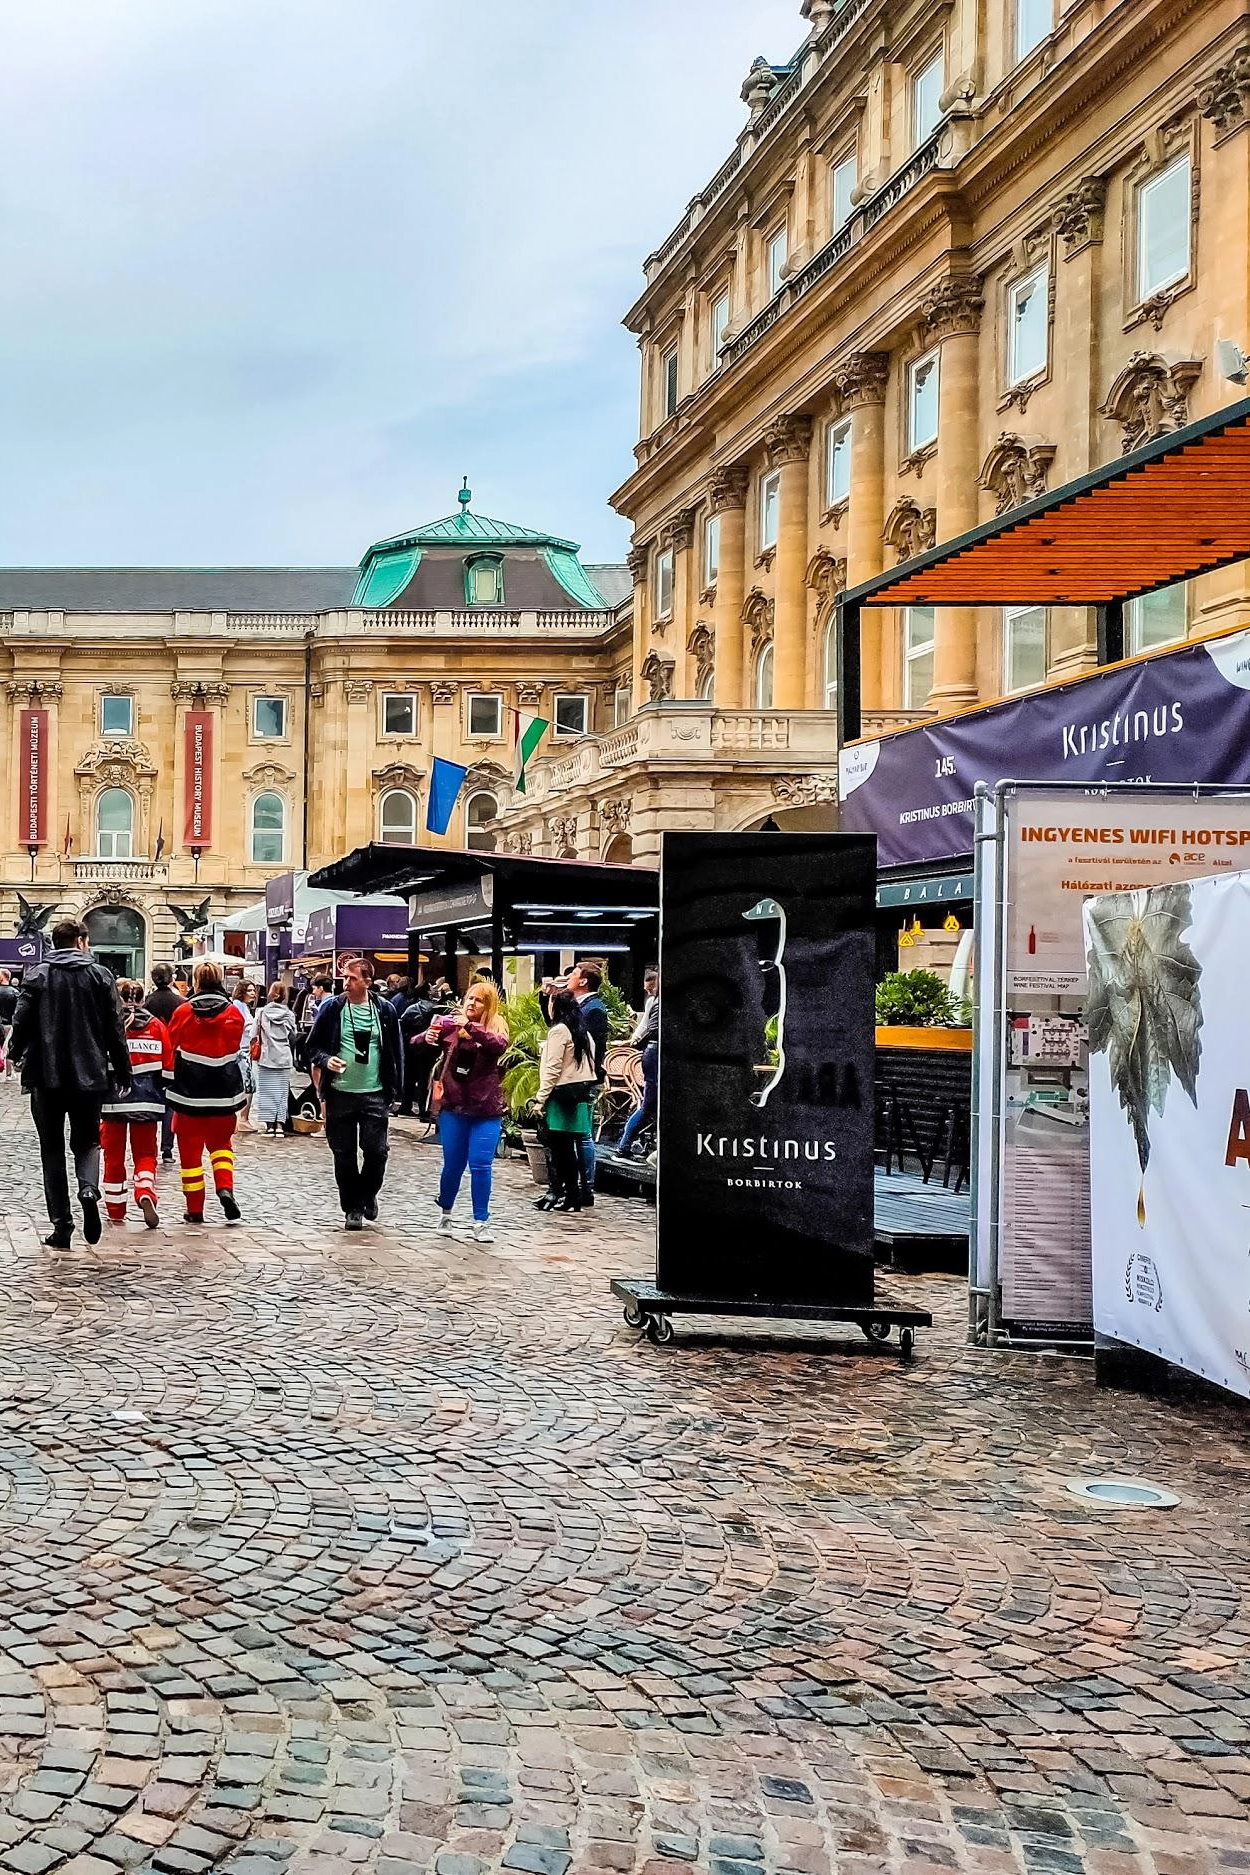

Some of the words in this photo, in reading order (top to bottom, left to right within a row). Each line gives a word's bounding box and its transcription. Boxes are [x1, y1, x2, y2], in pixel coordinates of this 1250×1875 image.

[195, 724, 203, 766] BUDAPEST
[1062, 701, 1184, 760] Kristinus
[29, 752, 38, 795] TÖRTÉNETI
[934, 755, 957, 778] 145.
[194, 767, 202, 801] HISTORY
[29, 797, 38, 840] BUDAPESTI
[193, 802, 202, 837] MUSEUM
[899, 805, 941, 825] KRISTINUS
[1021, 826, 1125, 843] INGYENES
[1129, 828, 1177, 845] WIFI
[1183, 852, 1206, 862] ace
[1061, 880, 1113, 891] Hálózati
[696, 1133, 837, 1162] Kristinus
[726, 1178, 803, 1190] BORBIRTOK
